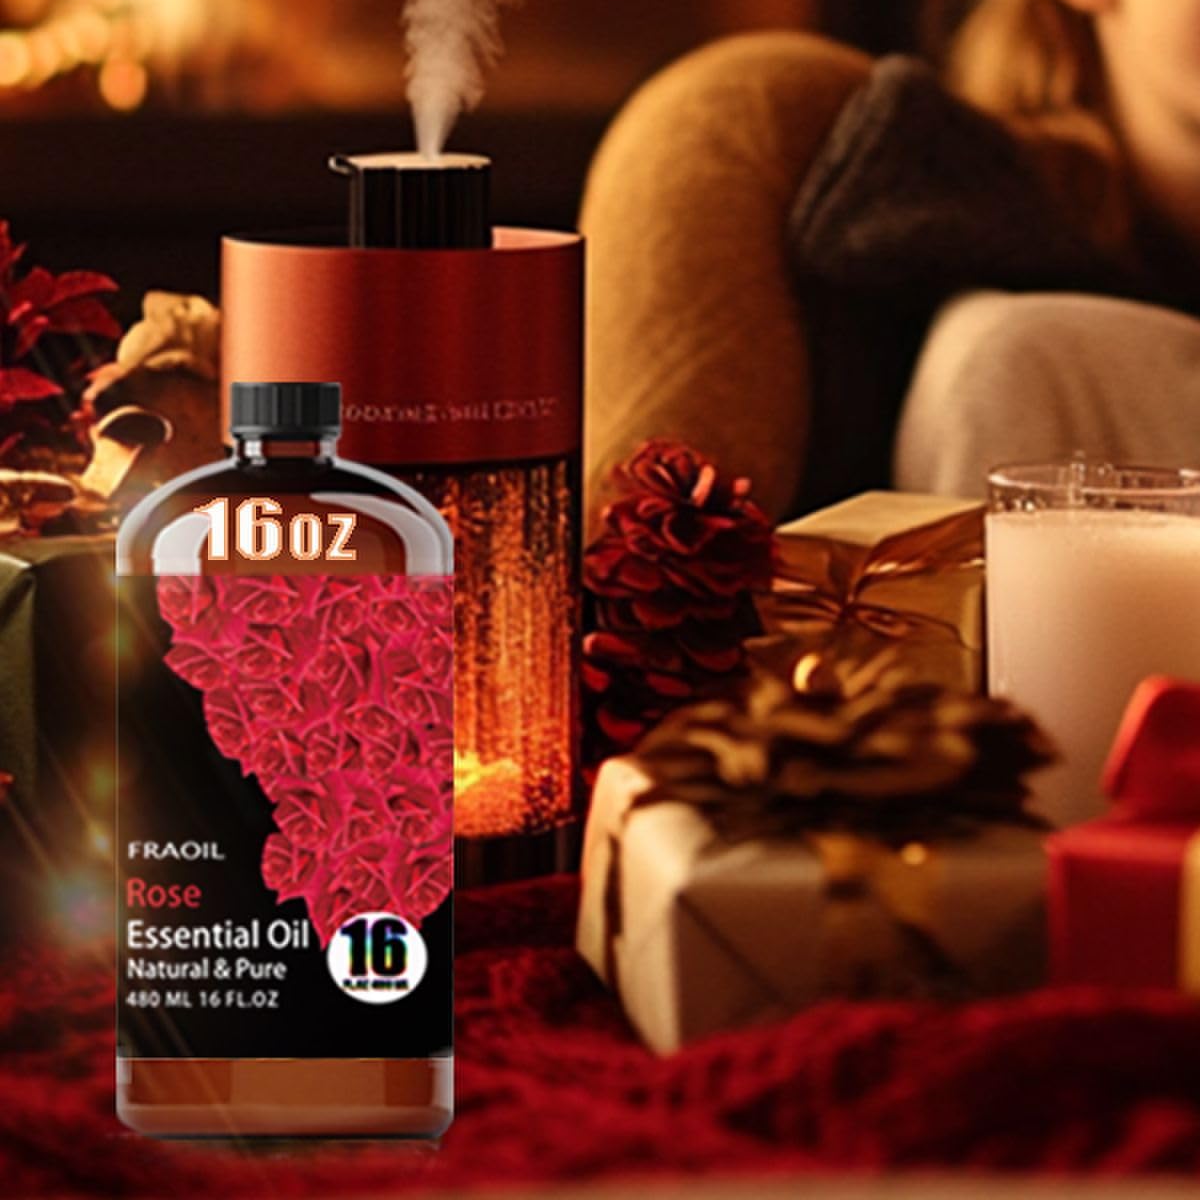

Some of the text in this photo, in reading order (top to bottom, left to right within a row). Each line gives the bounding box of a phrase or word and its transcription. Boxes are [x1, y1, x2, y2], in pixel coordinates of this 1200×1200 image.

[127, 841, 225, 861] FRAOIL
[126, 877, 202, 908] Rose
[126, 919, 310, 949] Essential Oil
[340, 917, 408, 977] 16
[126, 958, 287, 980] Natural & Pure
[126, 991, 160, 1008] 480
[165, 991, 192, 1008] ML
[200, 991, 221, 1008] 16
